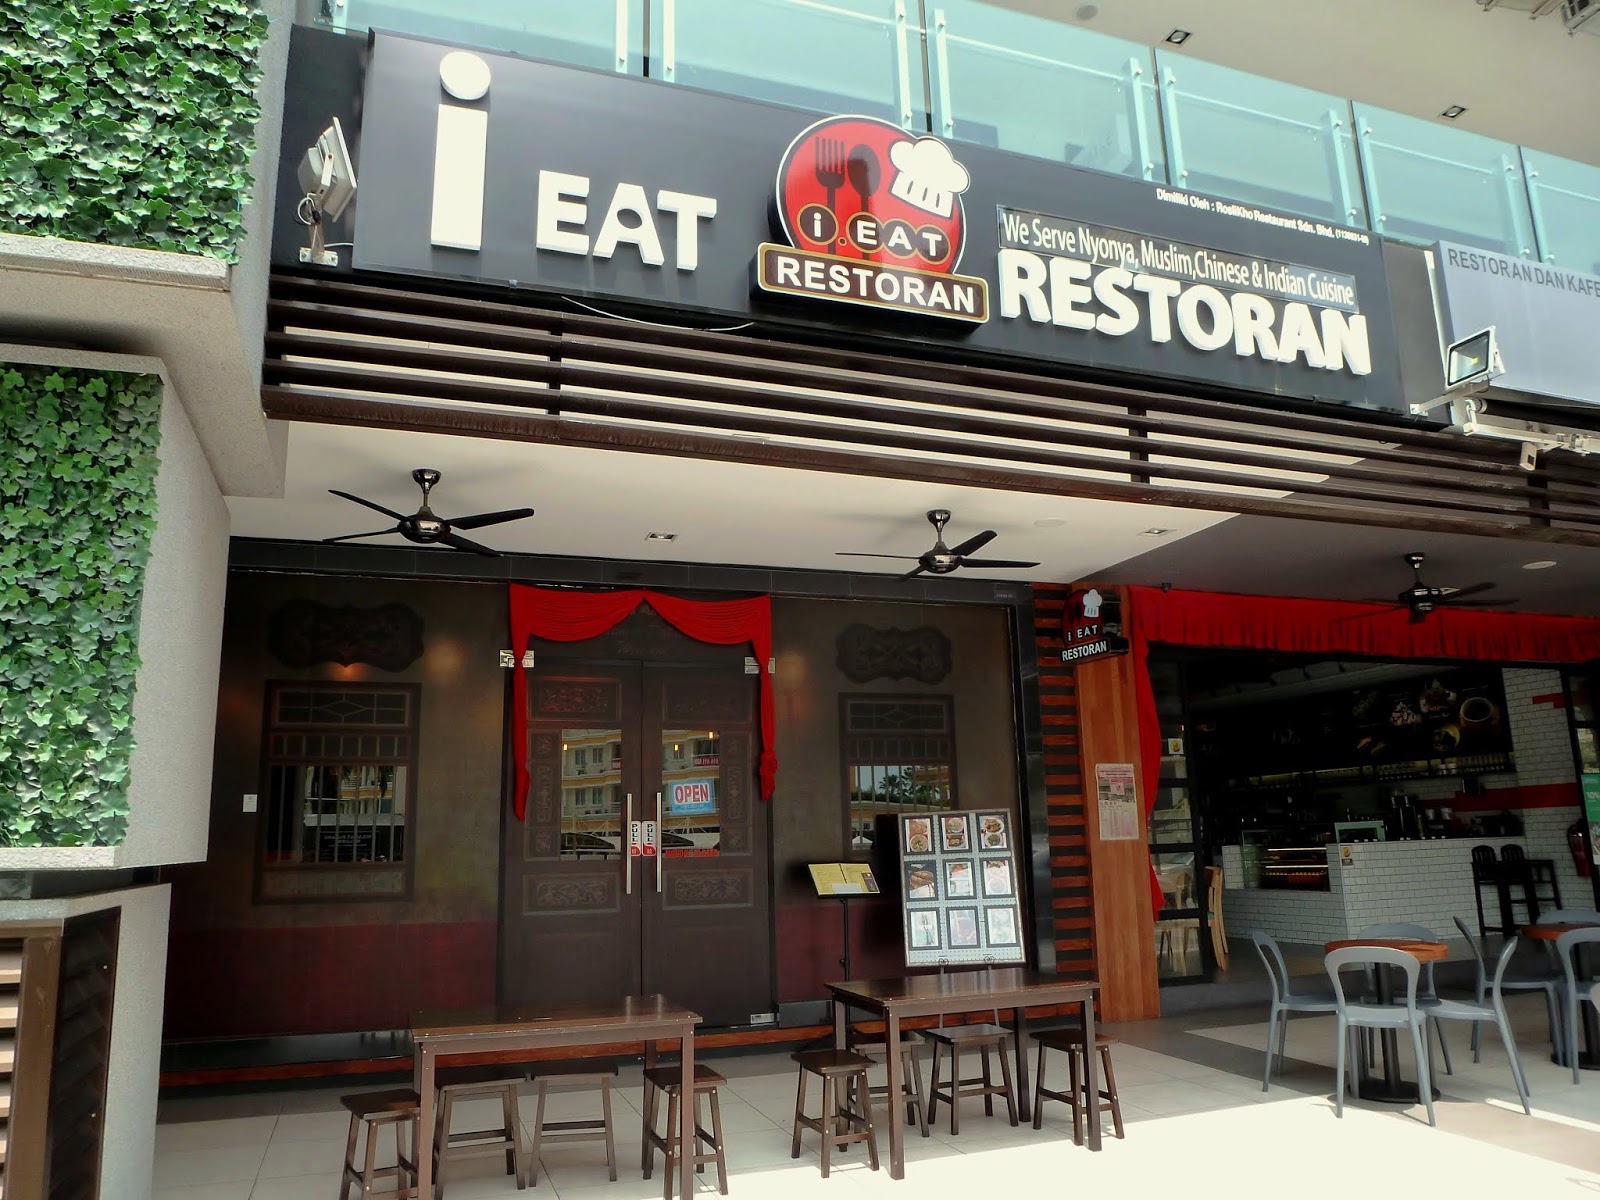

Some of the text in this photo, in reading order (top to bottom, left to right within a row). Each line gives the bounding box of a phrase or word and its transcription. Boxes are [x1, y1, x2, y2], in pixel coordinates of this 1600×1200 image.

[536, 169, 717, 271] EAT
[776, 255, 975, 314] RESTORAN
[1002, 211, 1030, 244] We
[1032, 218, 1076, 254] Serve
[1079, 227, 1139, 269] Nyonya,
[1251, 261, 1263, 289] &
[1264, 266, 1306, 297] Indian
[1307, 276, 1354, 306] Cuisine
[1448, 248, 1600, 298] RESTORAN DAN KAFE
[998, 248, 1372, 376] RESTORAN
[1061, 640, 1108, 662] RESTORAN
[1077, 624, 1098, 639] EAT
[675, 784, 709, 803] OPEN
